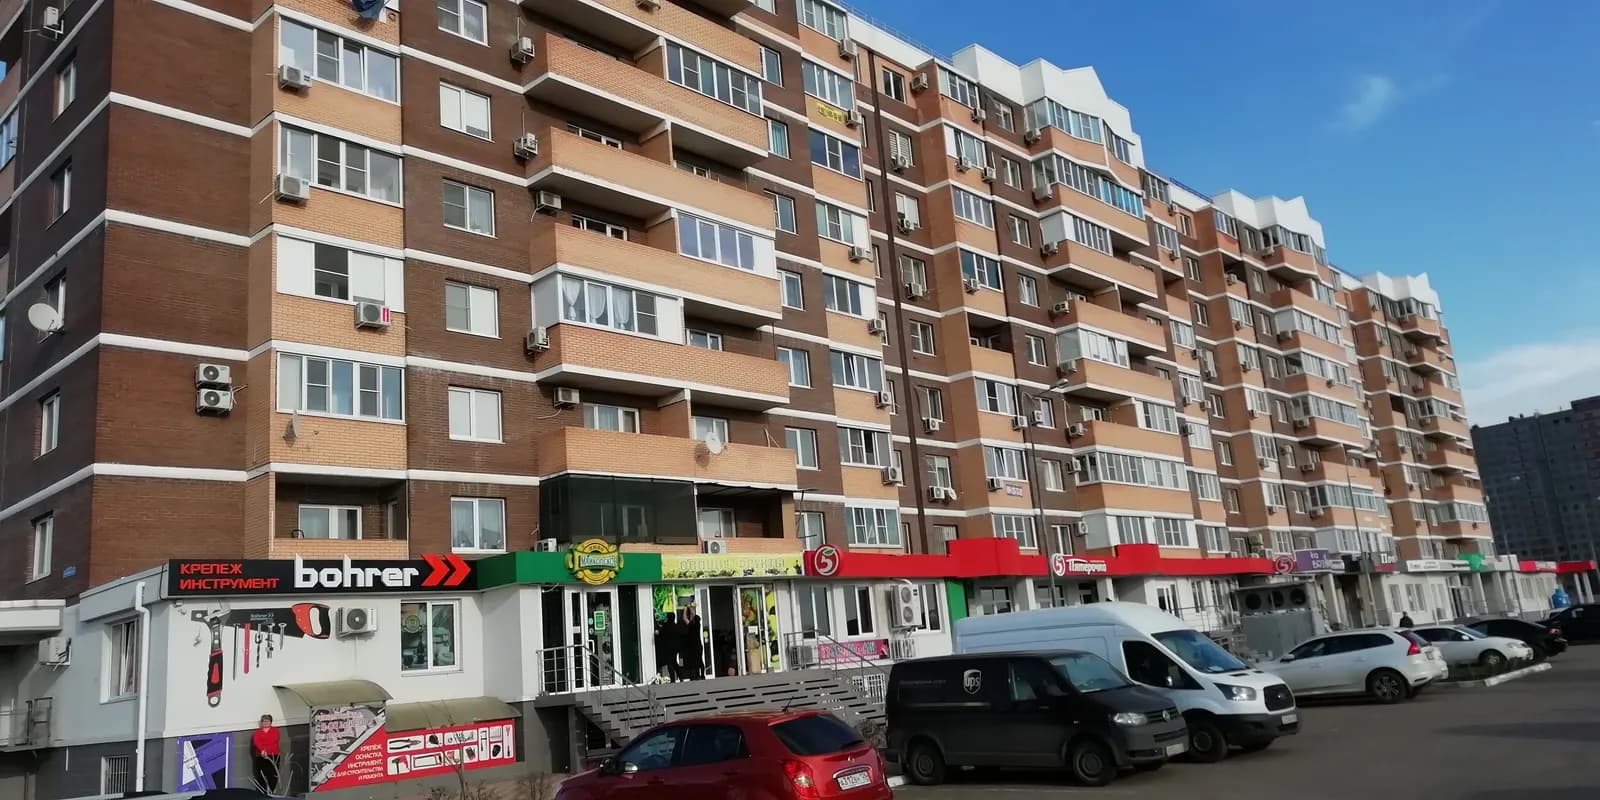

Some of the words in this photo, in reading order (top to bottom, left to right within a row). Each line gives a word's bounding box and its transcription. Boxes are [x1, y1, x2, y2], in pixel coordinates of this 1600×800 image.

[180, 563, 243, 575] КРЕПЕЖ
[294, 553, 419, 588] bohrer
[180, 578, 280, 590] ИНСТРУМЕНТ
